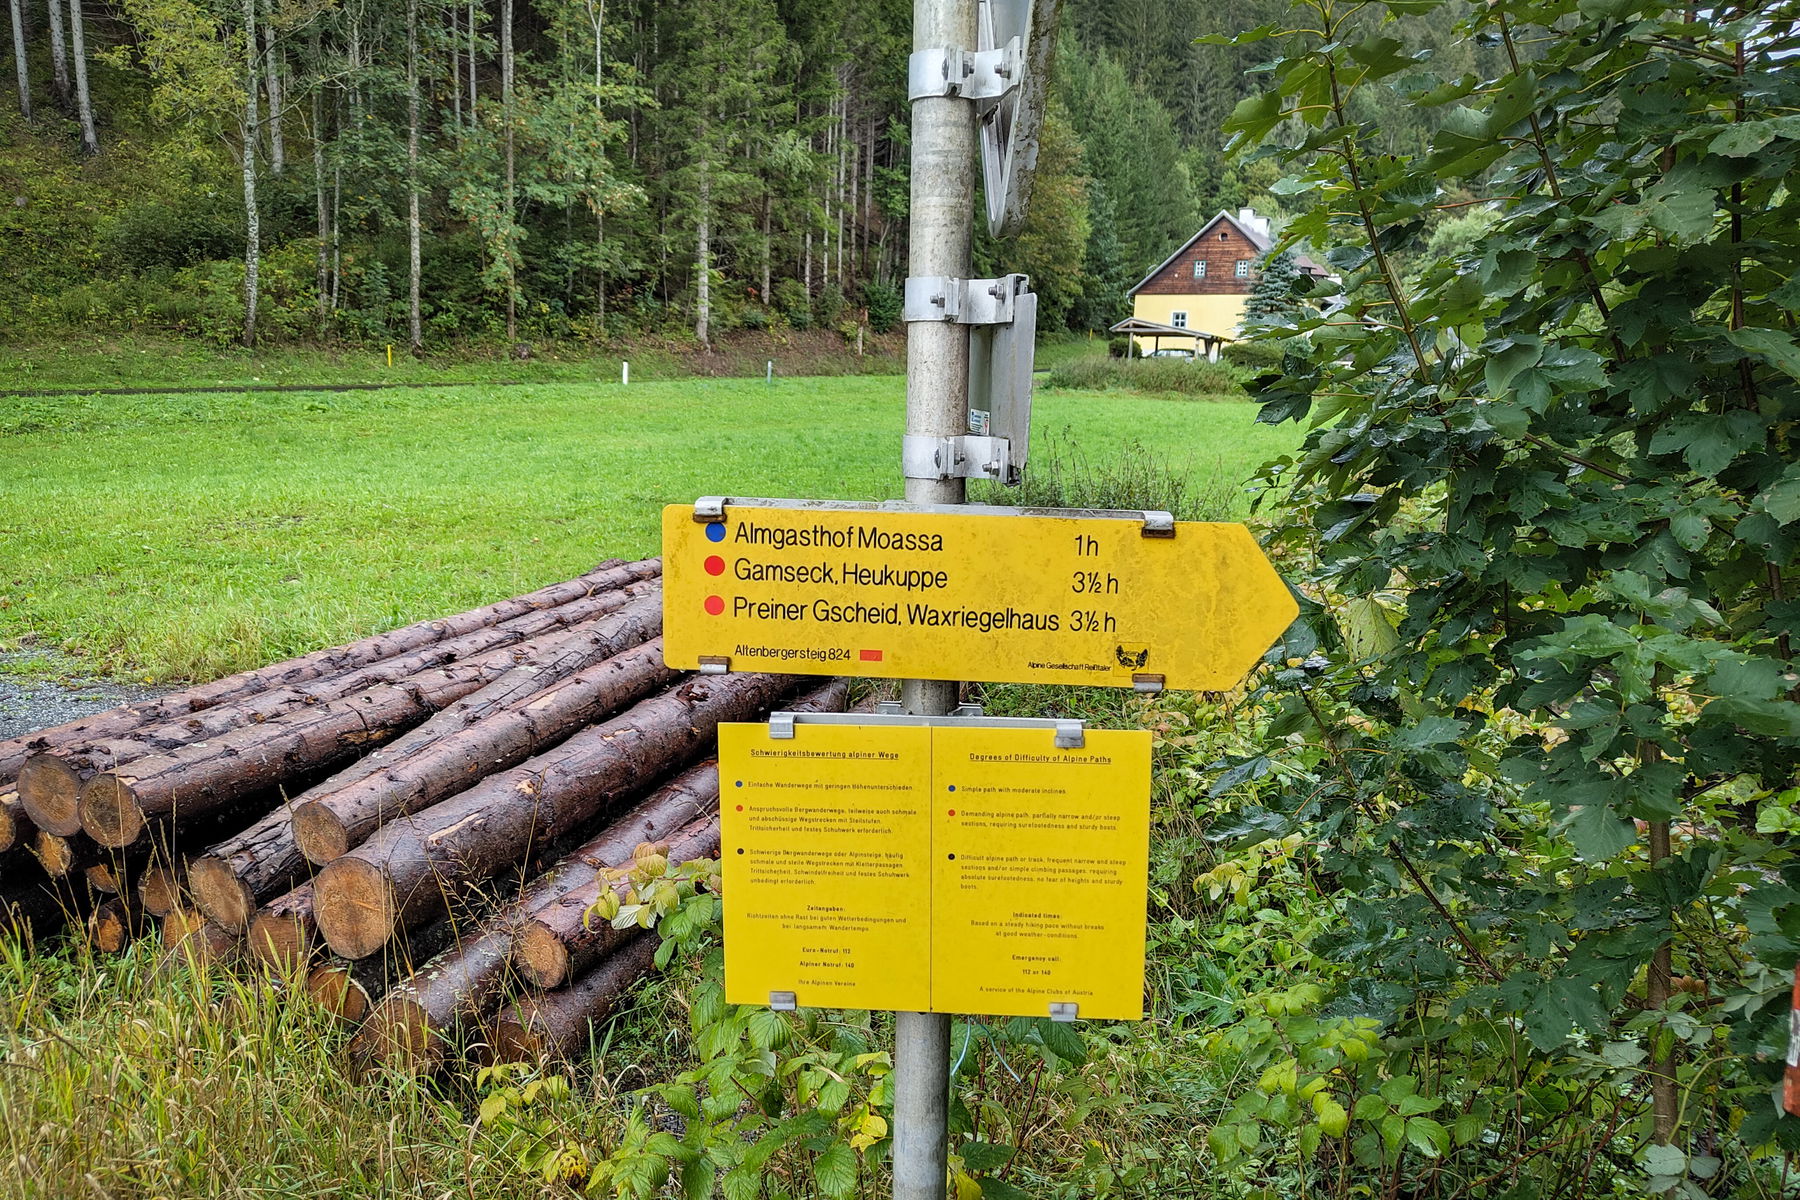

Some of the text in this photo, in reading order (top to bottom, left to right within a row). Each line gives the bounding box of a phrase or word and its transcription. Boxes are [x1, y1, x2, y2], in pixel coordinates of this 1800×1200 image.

[734, 522, 944, 551] Almgasthof Moassa
[734, 557, 948, 592] Gamseck, Heukuppe
[733, 596, 1059, 633] Preiner Gscheid, Waxriegelhaus
[735, 644, 851, 662] Altenbergersteig 824
[751, 749, 846, 759] Schwierigkeitsbewertung
[970, 753, 1002, 761] Degrees
[1015, 754, 1049, 762] Difficulty
